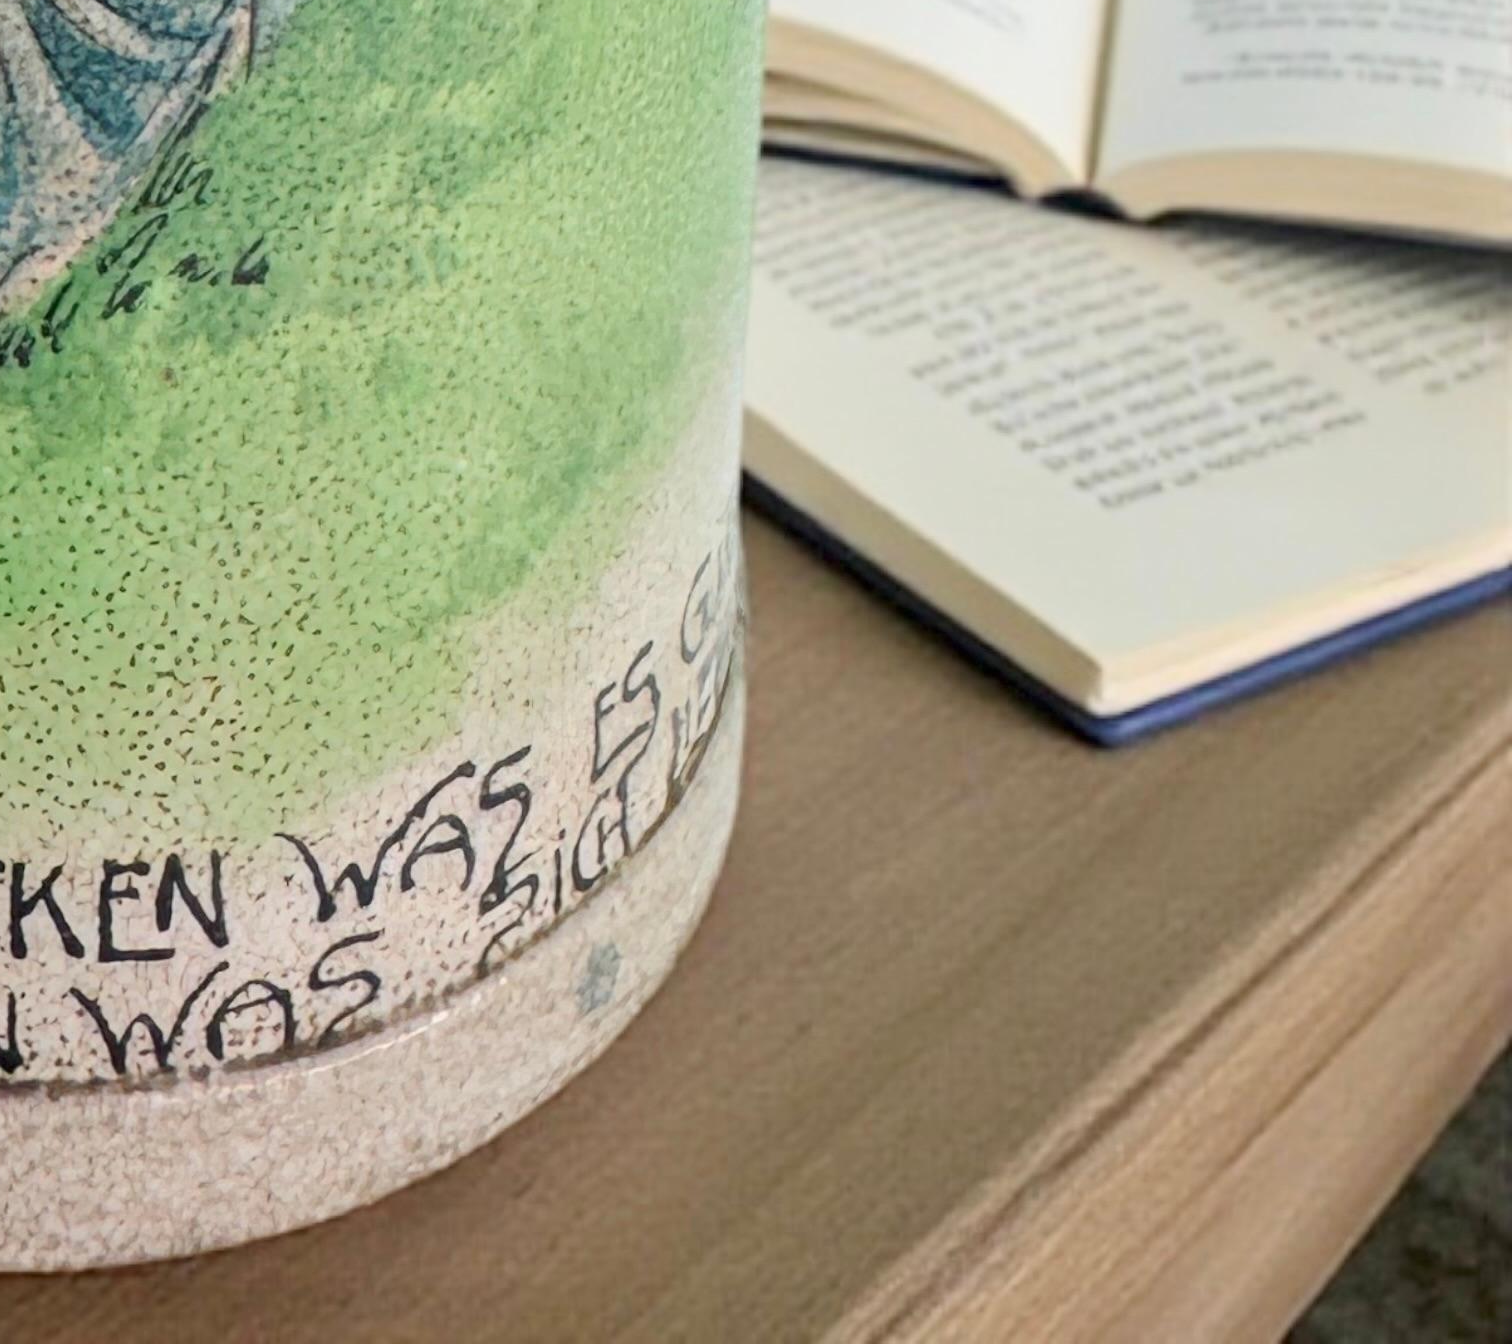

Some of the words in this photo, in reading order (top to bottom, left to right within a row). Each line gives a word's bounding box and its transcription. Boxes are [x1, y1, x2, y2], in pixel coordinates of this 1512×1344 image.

[276, 744, 536, 922] WAS
[590, 640, 662, 784] ES
[74, 936, 383, 1076] WAS
